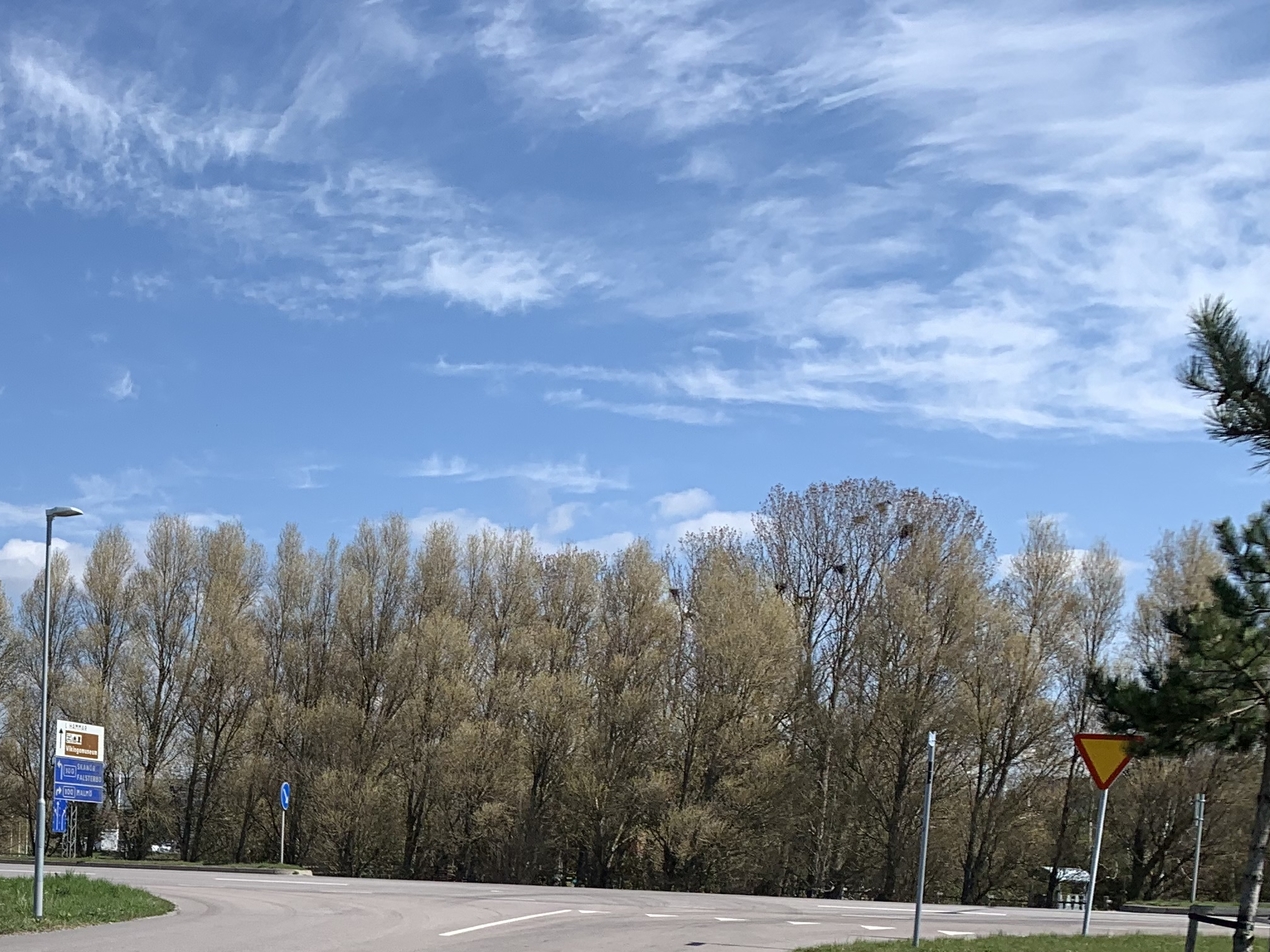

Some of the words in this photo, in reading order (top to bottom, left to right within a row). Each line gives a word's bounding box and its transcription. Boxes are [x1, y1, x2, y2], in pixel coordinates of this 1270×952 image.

[76, 774, 102, 783] FALSTERBO
[64, 788, 74, 796] 100
[76, 789, 93, 797] MALMÖ
